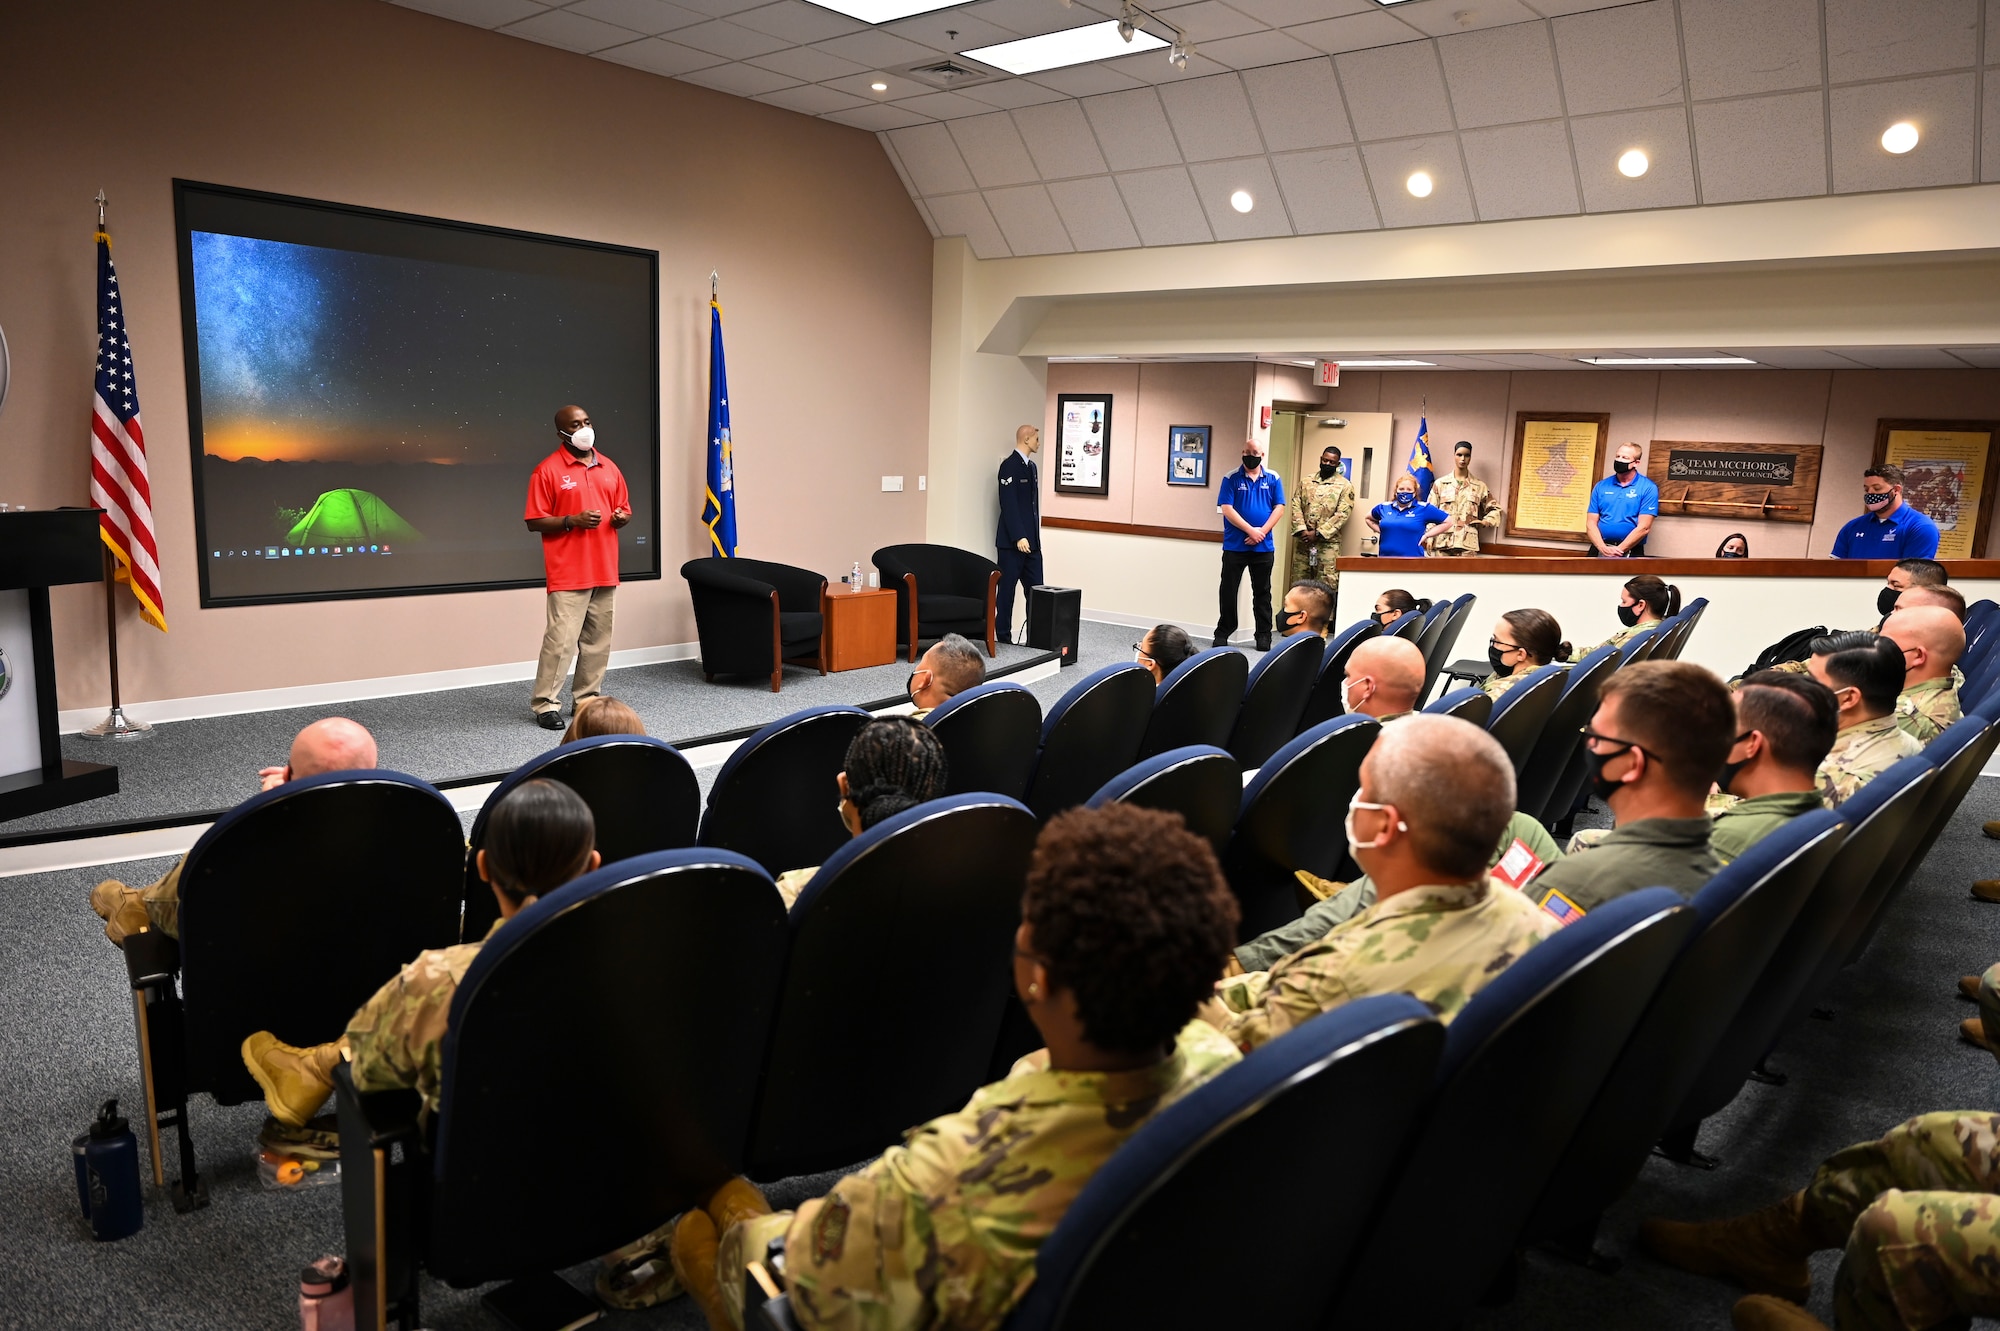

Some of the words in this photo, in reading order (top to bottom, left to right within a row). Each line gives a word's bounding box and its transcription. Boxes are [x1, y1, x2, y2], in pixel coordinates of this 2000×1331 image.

[1323, 363, 1337, 383] EXIT
[1687, 459, 1717, 468] TEAM
[1719, 461, 1775, 471] MCCHORD
